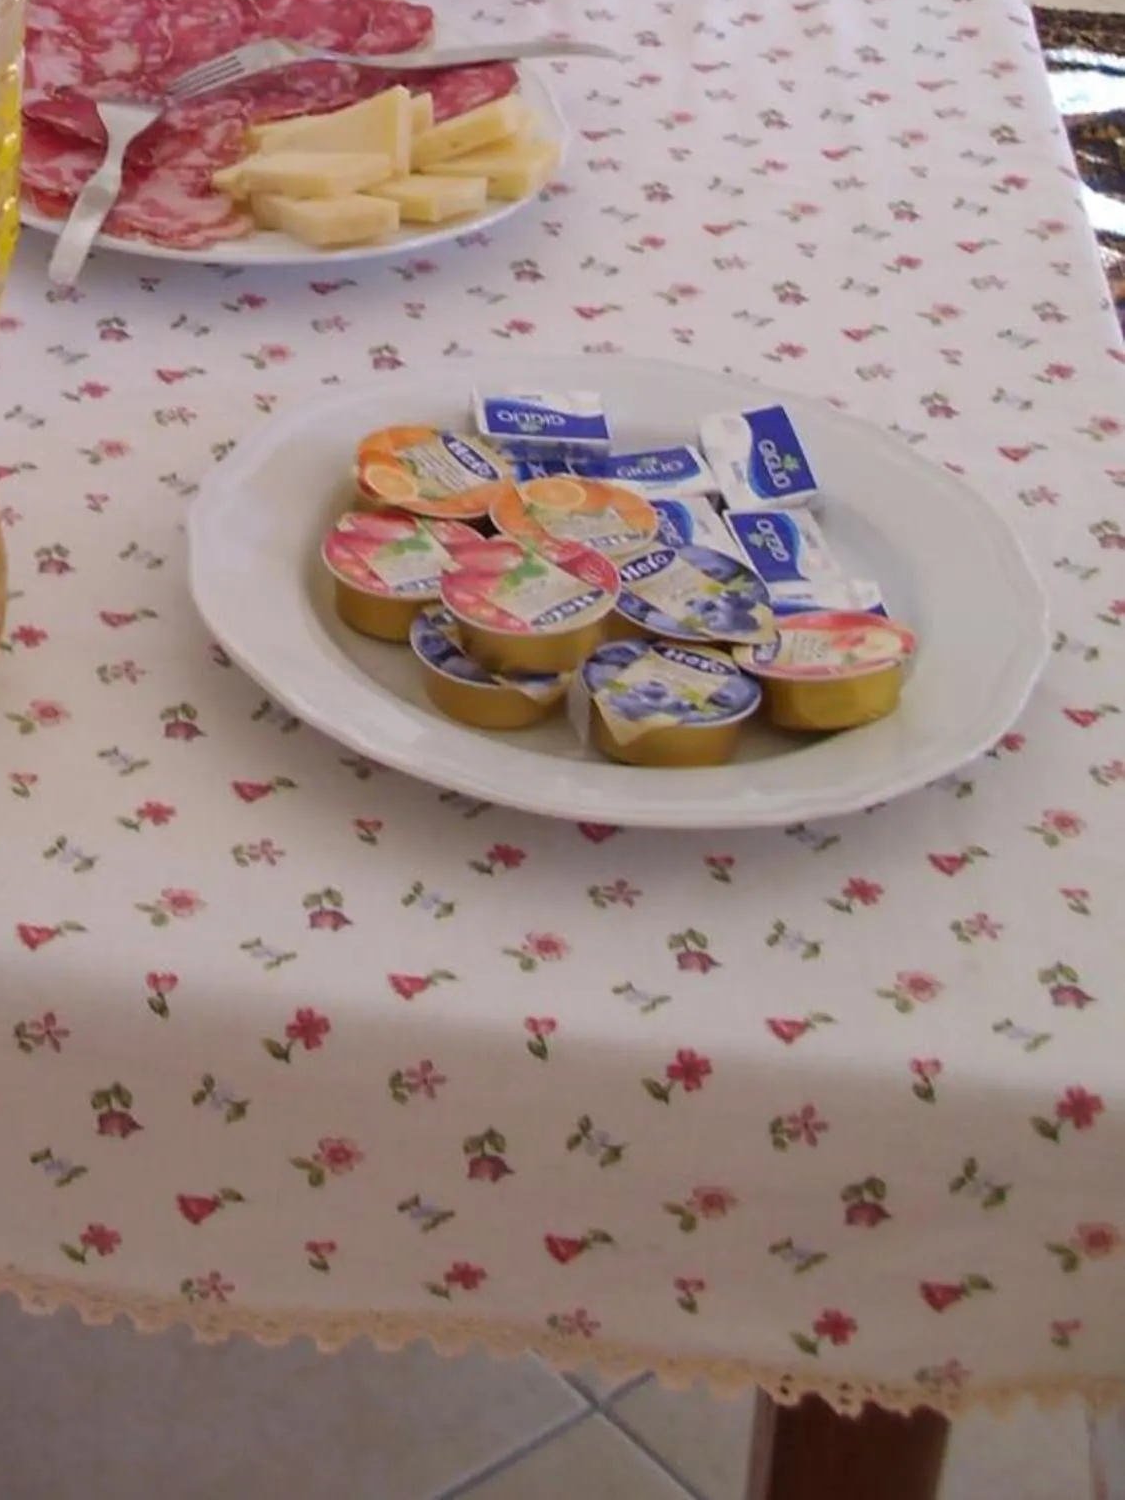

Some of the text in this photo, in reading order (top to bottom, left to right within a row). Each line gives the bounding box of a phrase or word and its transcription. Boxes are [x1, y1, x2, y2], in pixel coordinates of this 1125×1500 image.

[496, 409, 567, 428] GIGLIO
[446, 439, 495, 477] Hero
[615, 457, 685, 479] GIGLIO
[758, 440, 793, 490] GIGLIO
[621, 551, 671, 582] Hero
